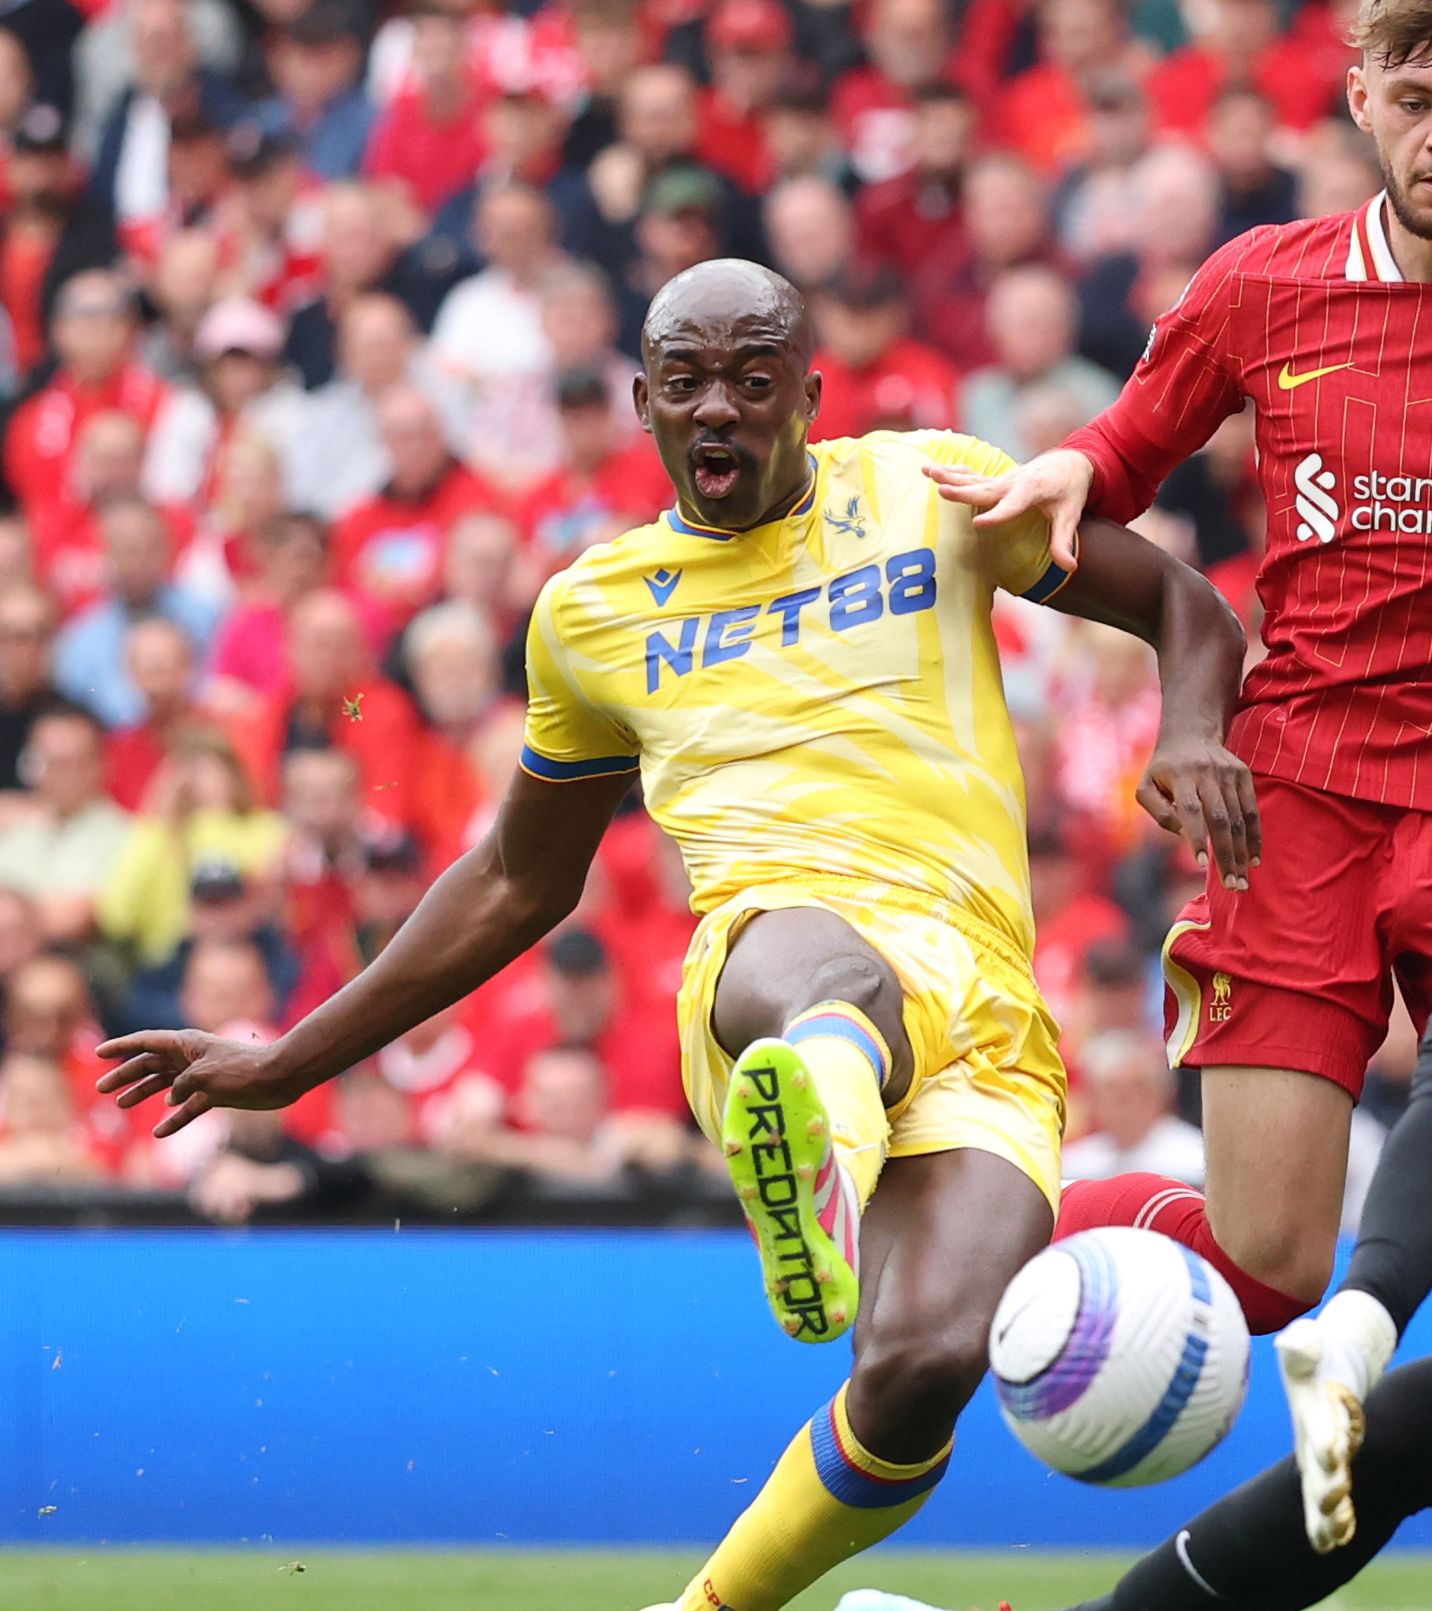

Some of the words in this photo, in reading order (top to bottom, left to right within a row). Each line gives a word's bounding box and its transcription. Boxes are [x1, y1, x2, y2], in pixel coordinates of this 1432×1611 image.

[645, 548, 937, 695] NET88
[1209, 1007, 1232, 1021] LFC
[704, 1578, 721, 1607] CP
